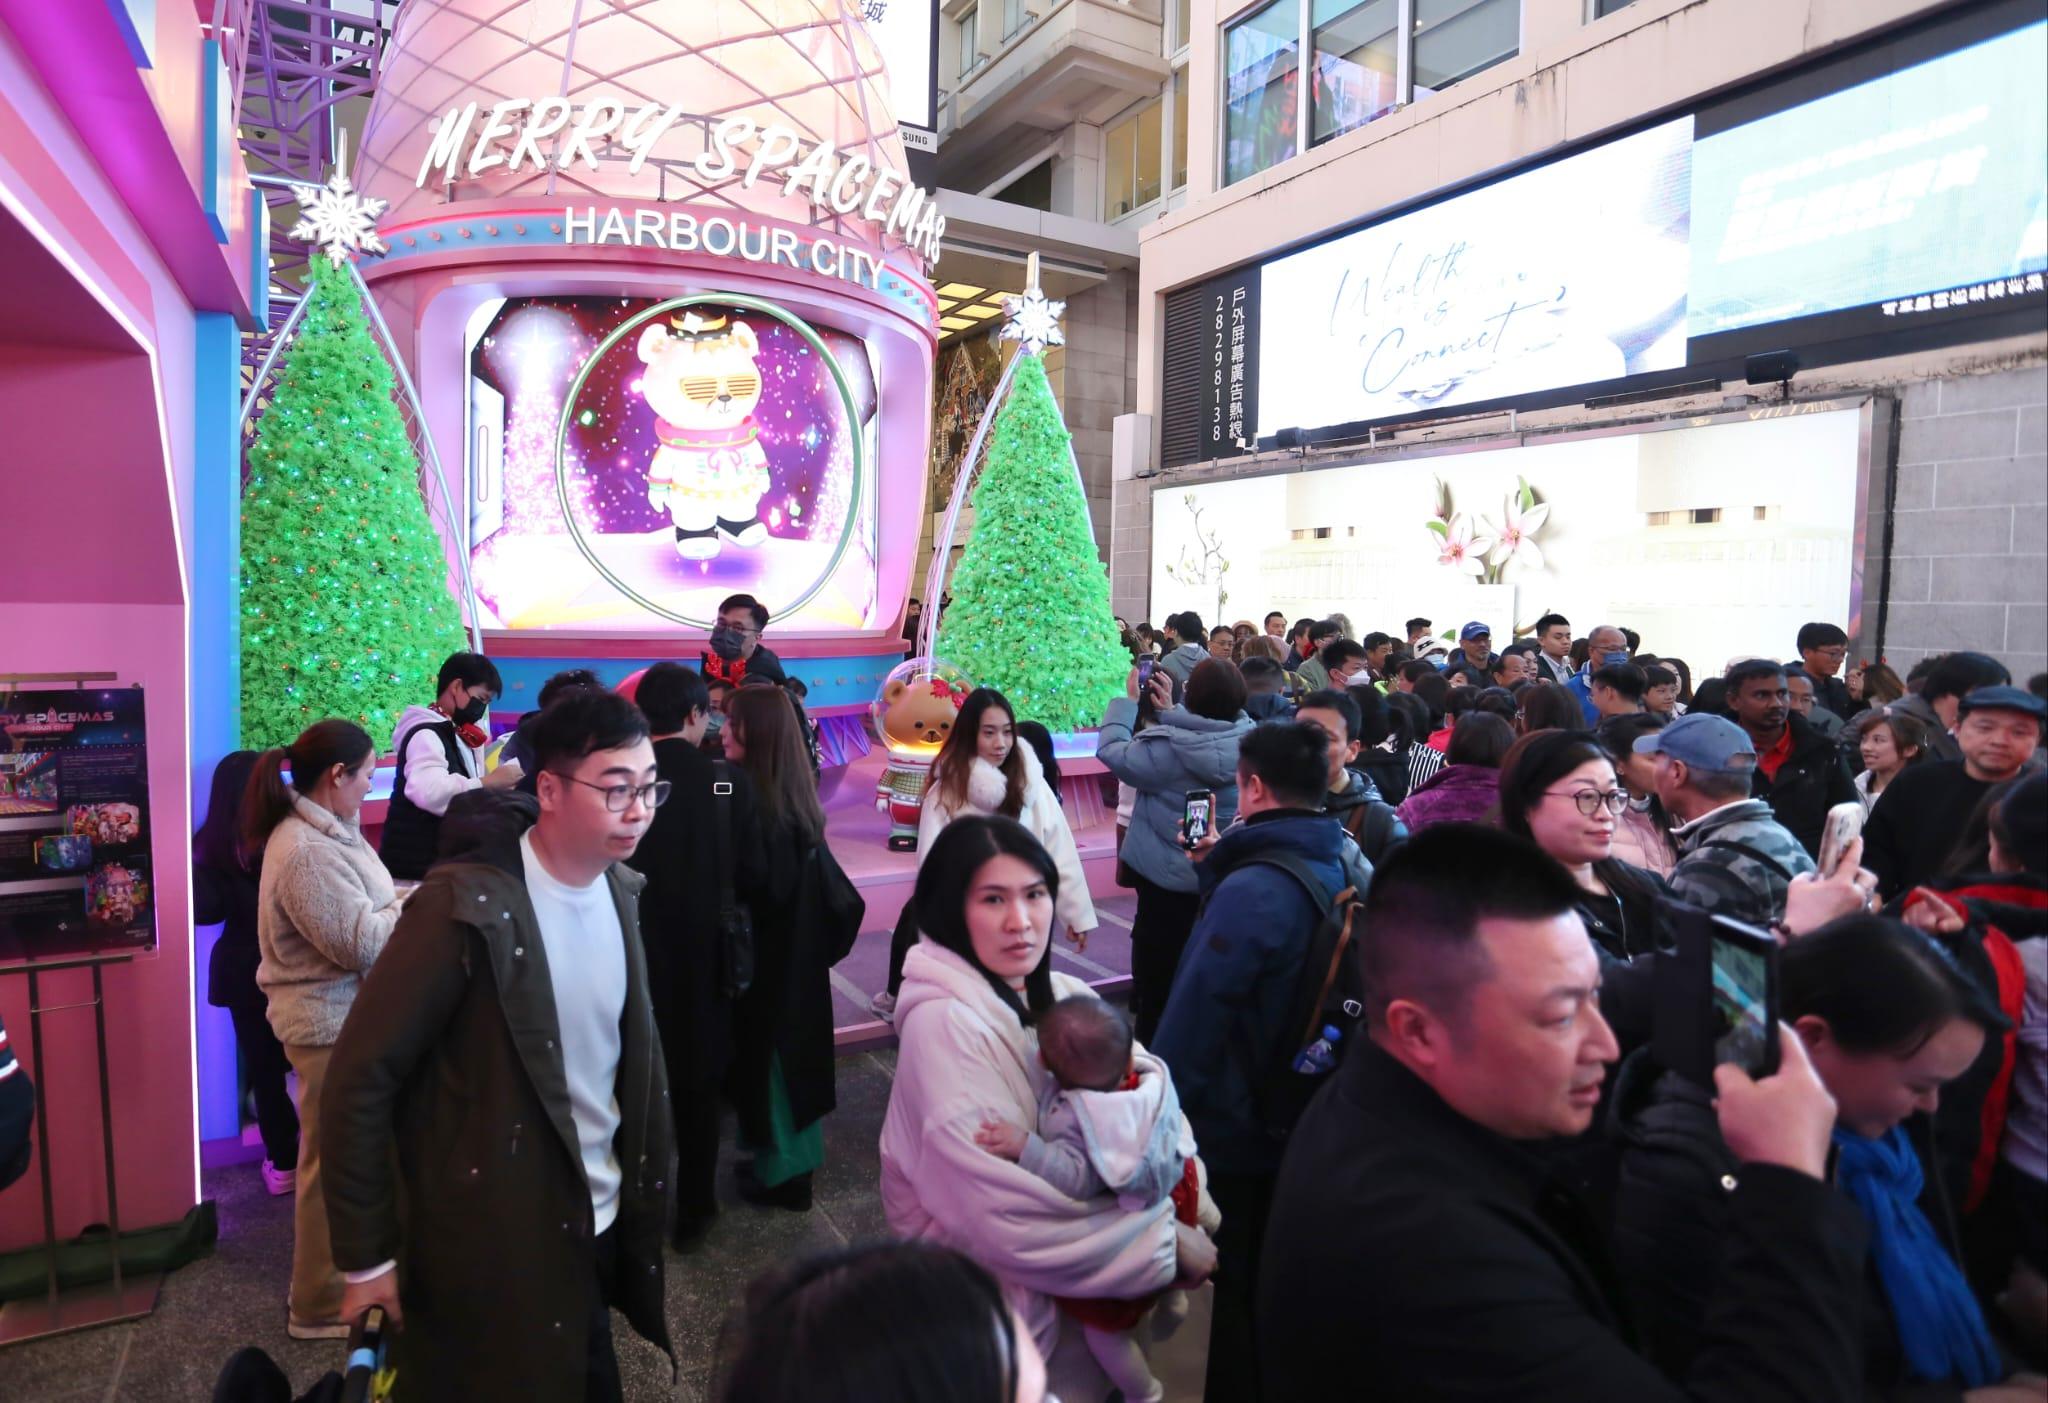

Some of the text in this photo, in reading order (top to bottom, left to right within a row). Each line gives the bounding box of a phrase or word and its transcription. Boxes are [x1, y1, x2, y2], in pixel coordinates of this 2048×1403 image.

[416, 96, 946, 264] MERRY SPACEMAS
[565, 207, 885, 289] HARBOUR CITY
[1212, 295, 1224, 441] 28298138
